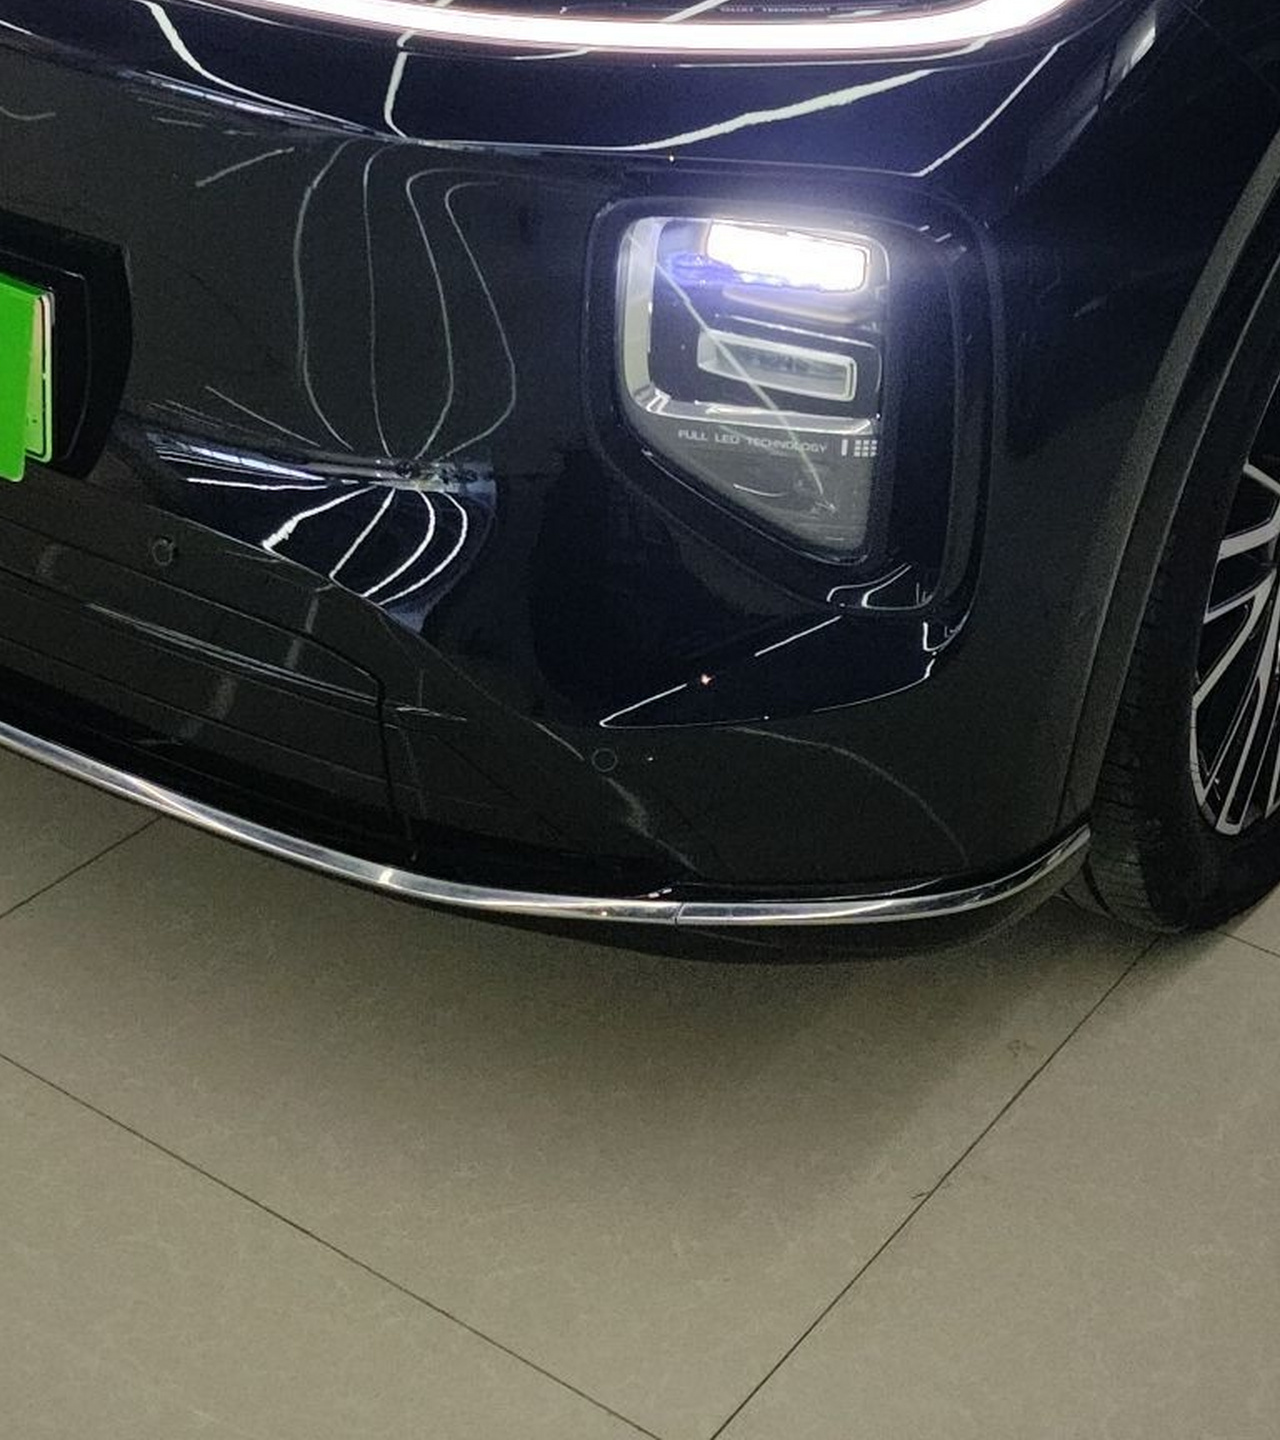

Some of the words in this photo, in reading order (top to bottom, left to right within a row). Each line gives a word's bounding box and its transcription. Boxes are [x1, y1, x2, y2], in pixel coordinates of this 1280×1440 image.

[678, 428, 707, 441] FULL
[714, 433, 740, 445] LED
[747, 437, 828, 455] TECHNOLOGY
